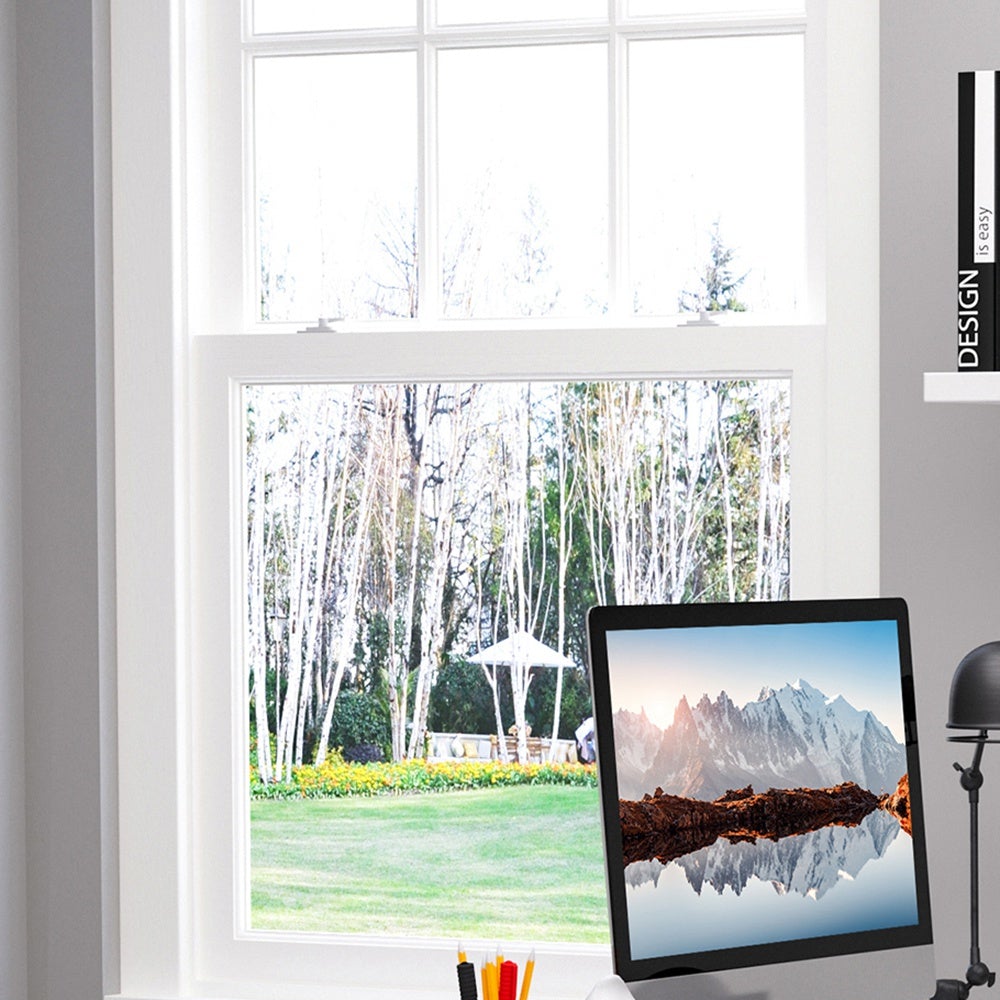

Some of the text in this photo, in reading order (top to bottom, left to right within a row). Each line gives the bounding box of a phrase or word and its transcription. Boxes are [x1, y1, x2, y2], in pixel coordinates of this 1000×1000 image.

[976, 206, 992, 256] is easy
[959, 270, 979, 367] DESIGN
